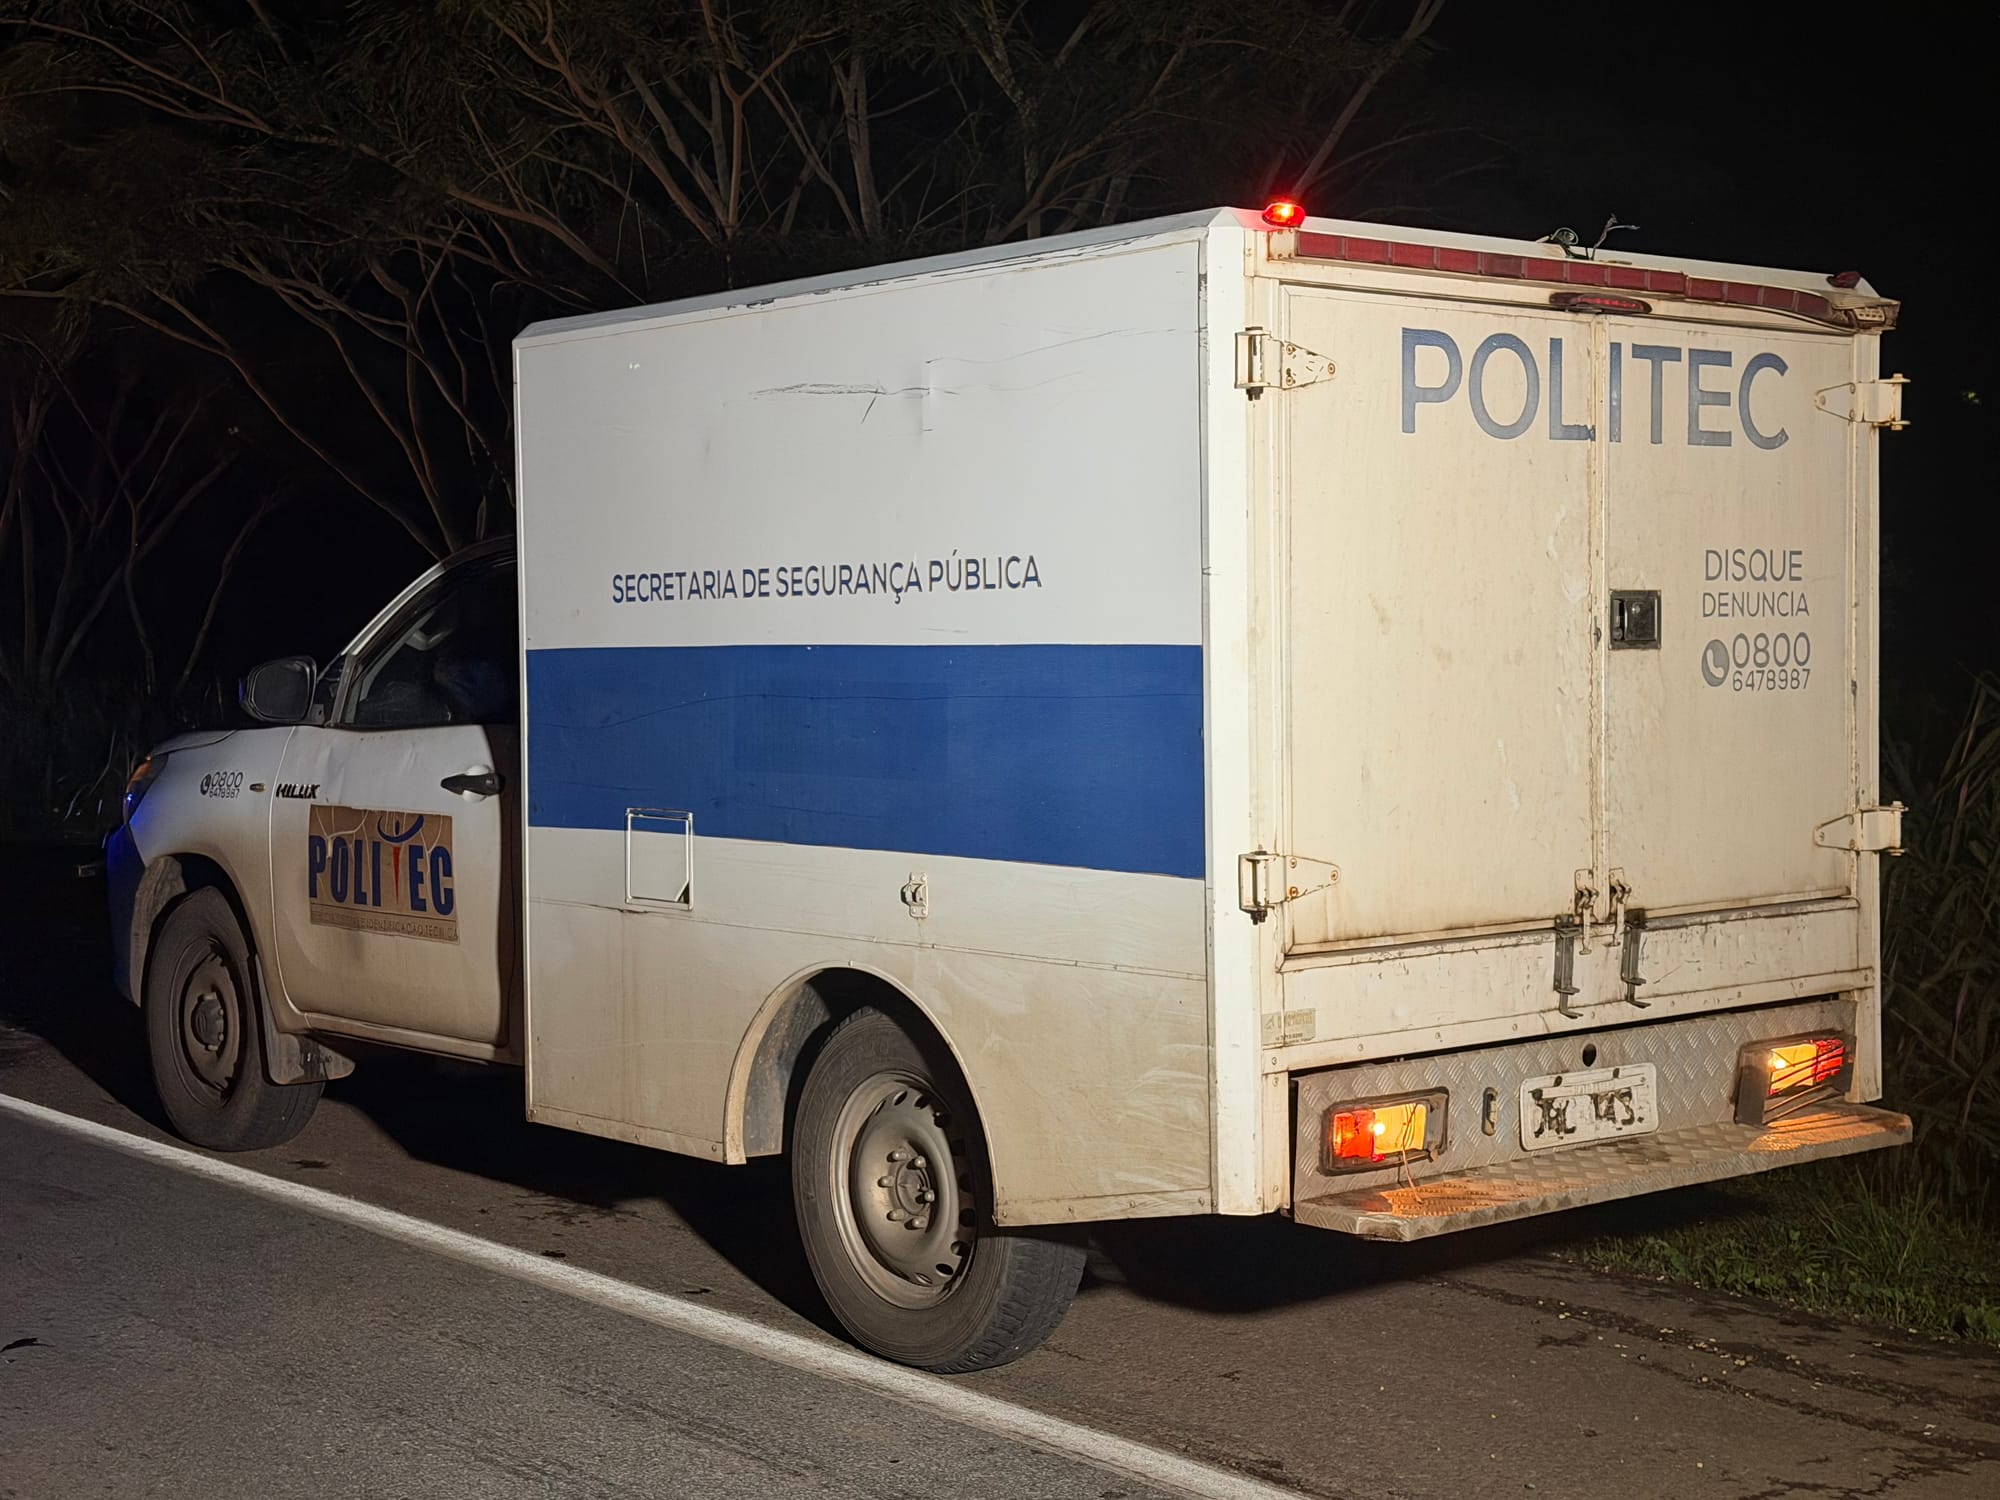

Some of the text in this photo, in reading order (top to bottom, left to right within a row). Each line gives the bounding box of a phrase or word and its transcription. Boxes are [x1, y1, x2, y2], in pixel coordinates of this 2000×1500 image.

[1402, 327, 1789, 450] POLITEC
[612, 549, 1042, 604] SECRETARIA DE SEGURANÇA PÚBLICA
[1705, 549, 1803, 582] DISQUE
[1702, 591, 1809, 617] DENUNCIA
[1732, 632, 1811, 668] 0800
[1732, 669, 1811, 691] 6478987
[212, 771, 243, 788] 0800
[276, 783, 320, 799] HILUX
[309, 815, 454, 916] POLITEC
